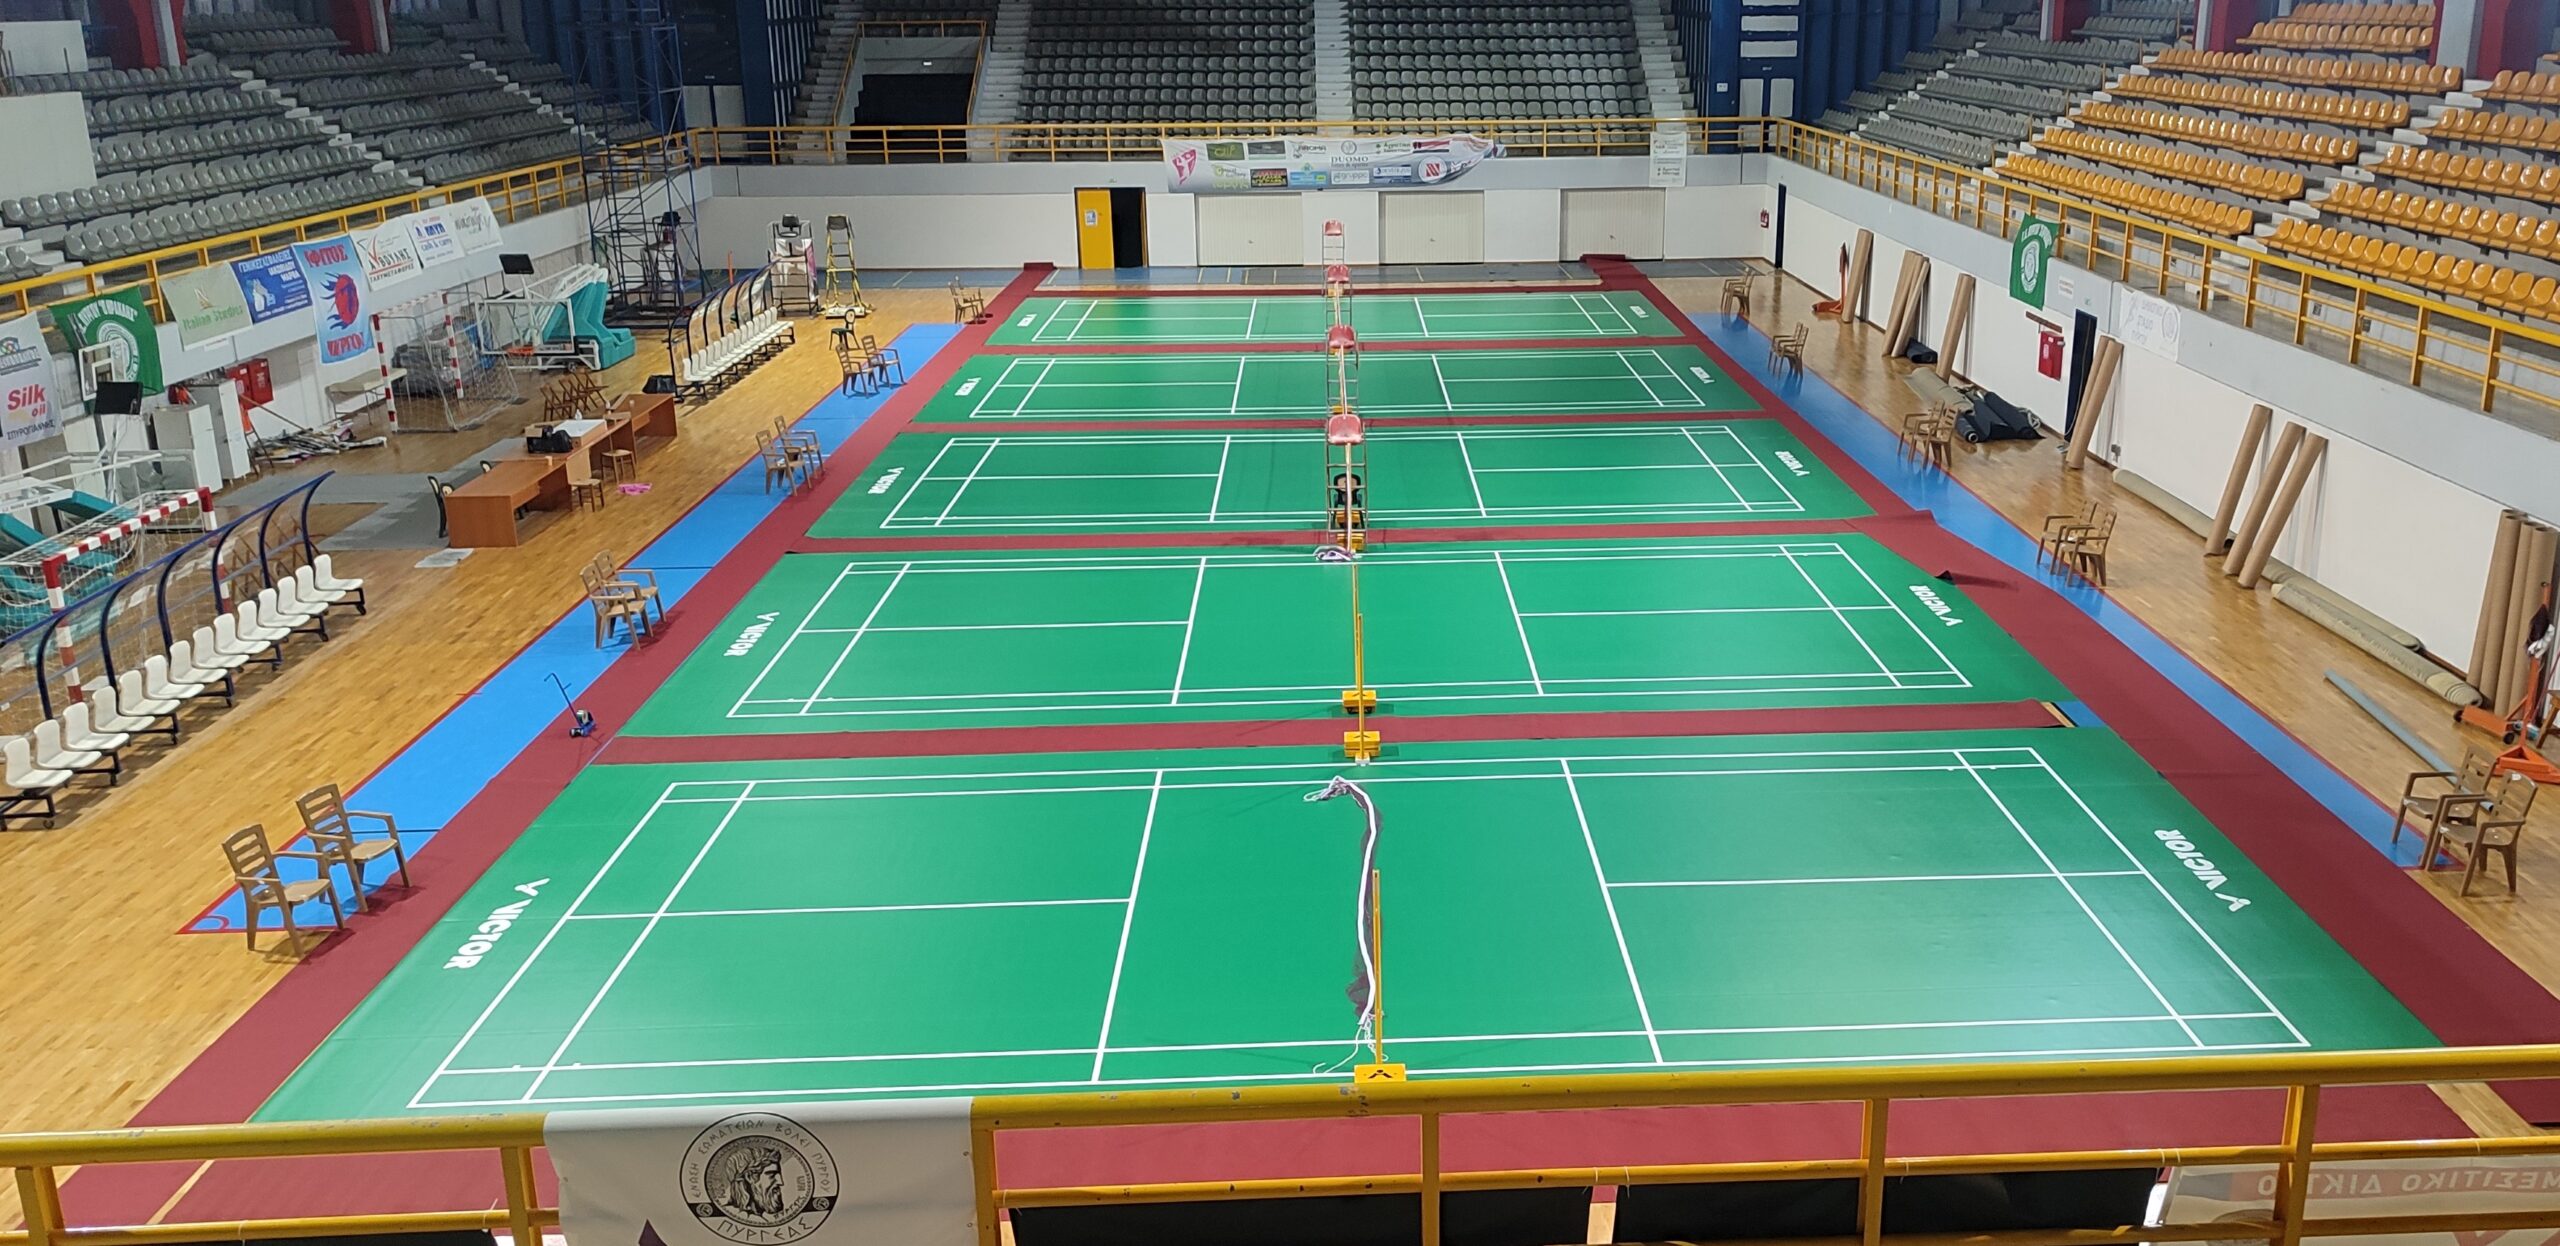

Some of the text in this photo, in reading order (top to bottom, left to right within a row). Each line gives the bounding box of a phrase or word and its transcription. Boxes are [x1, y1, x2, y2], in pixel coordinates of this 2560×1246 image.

[182, 314, 212, 331] Italian
[212, 305, 243, 322] Studies
[7, 384, 46, 412] Silk
[31, 404, 46, 417] oil
[1909, 585, 1952, 616] VICTOR
[723, 622, 772, 656] VICTOR
[2154, 829, 2228, 891] VICTOR
[443, 898, 532, 970] VICTOR
[698, 1119, 765, 1155] ΣΩΜΑΤΕΙΩΝ
[811, 1152, 831, 1193] ΠΥΡΓΟΥ
[717, 1216, 813, 1243] ΠΥΡΓΕΑΣ
